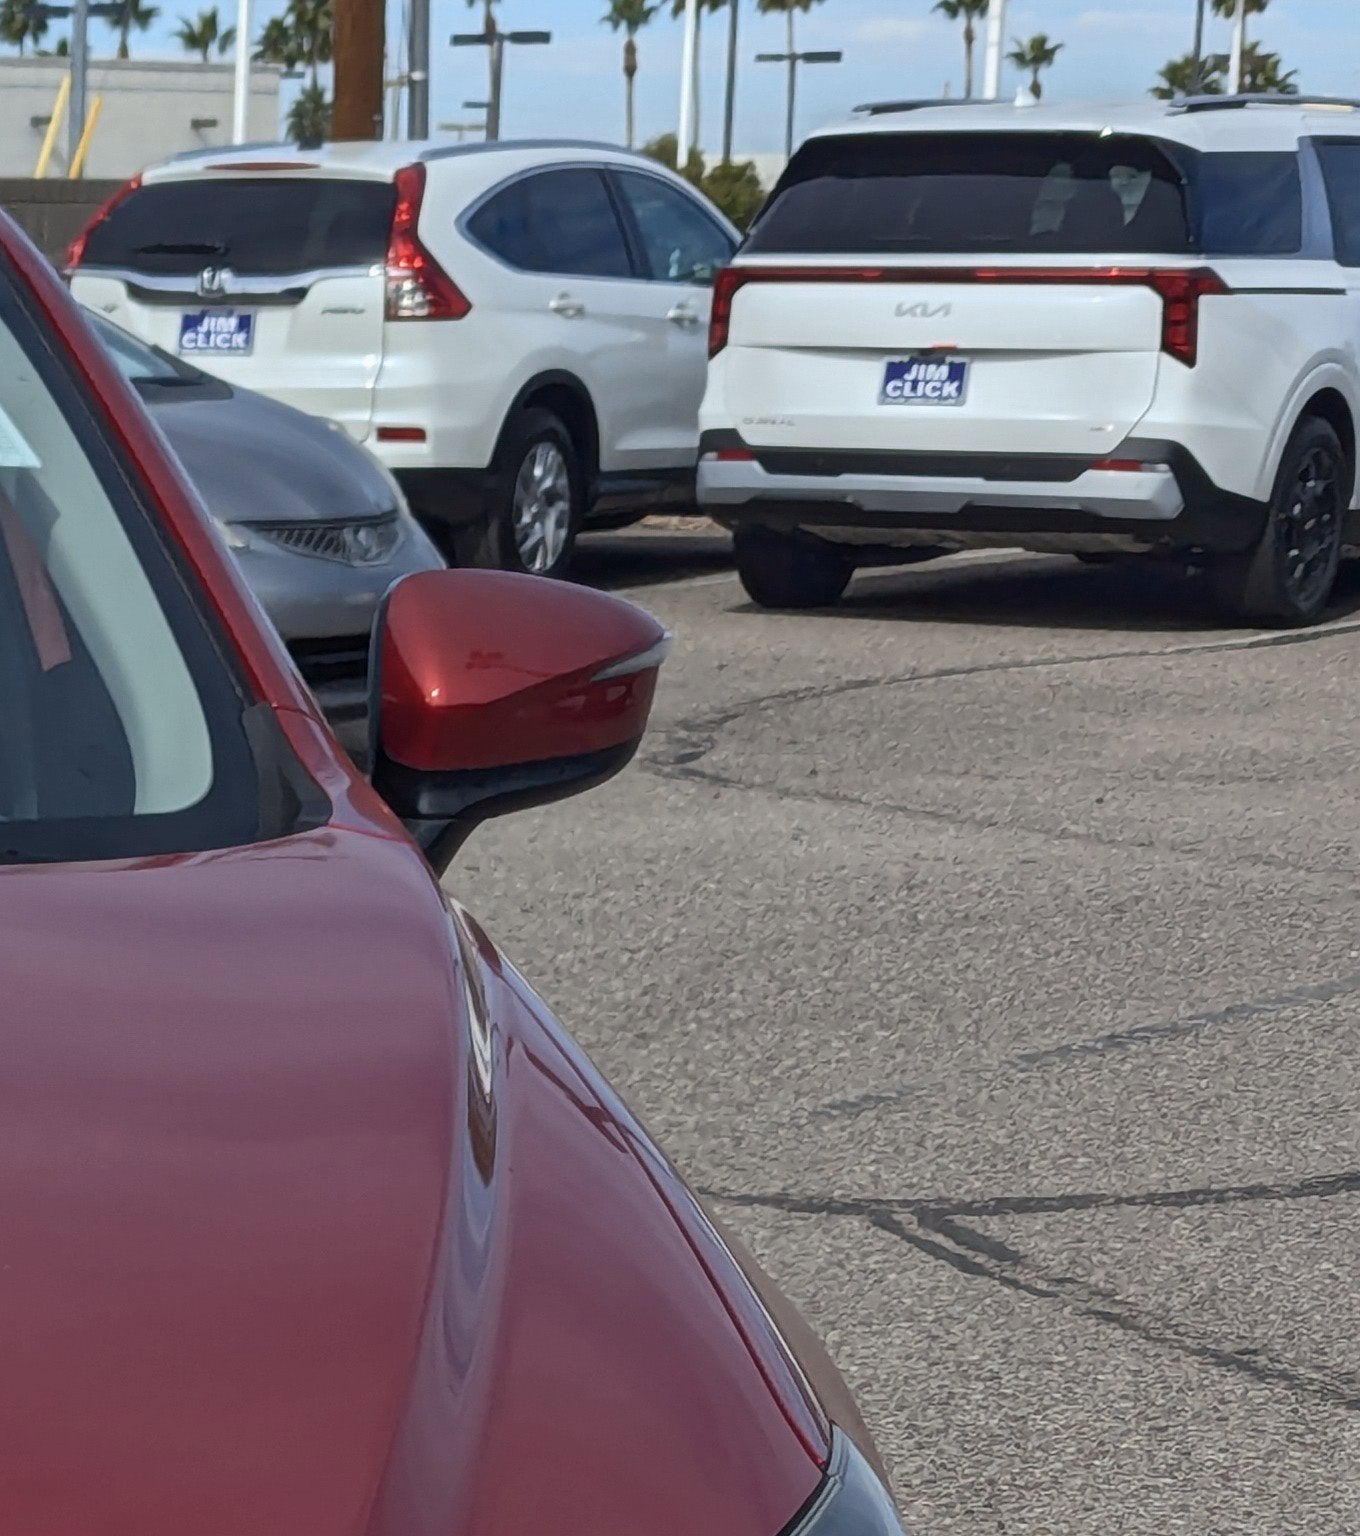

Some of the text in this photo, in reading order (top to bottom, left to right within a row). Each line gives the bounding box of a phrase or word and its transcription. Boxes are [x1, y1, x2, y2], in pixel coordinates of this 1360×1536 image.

[197, 316, 237, 332] JIM
[182, 331, 247, 348] CLICK
[903, 364, 949, 380] JIM
[885, 380, 960, 397] CLICK
